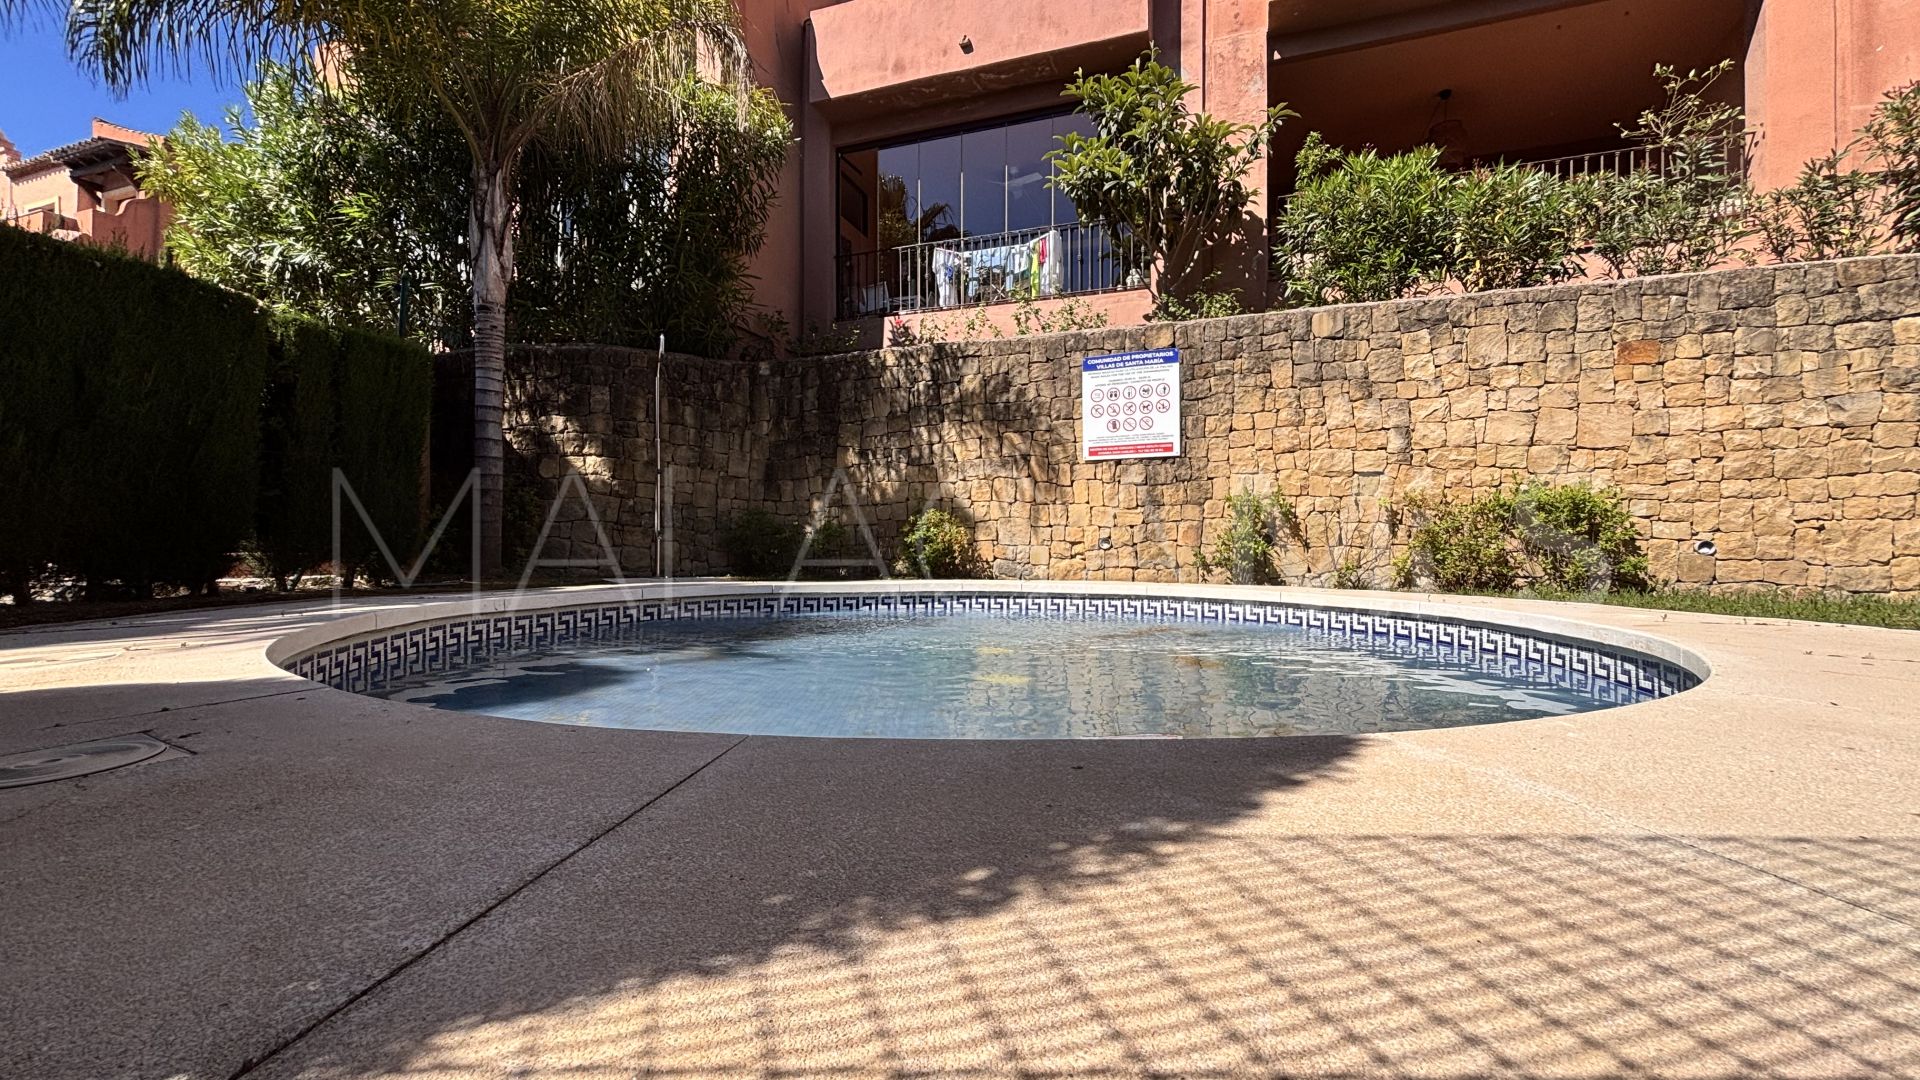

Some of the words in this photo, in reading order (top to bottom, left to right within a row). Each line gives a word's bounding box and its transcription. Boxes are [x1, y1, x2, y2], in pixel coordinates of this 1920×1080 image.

[1087, 356, 1122, 365] COMUNIDAD
[1131, 351, 1174, 360] PROPIETARIOS
[1144, 357, 1164, 365] MARÍA
